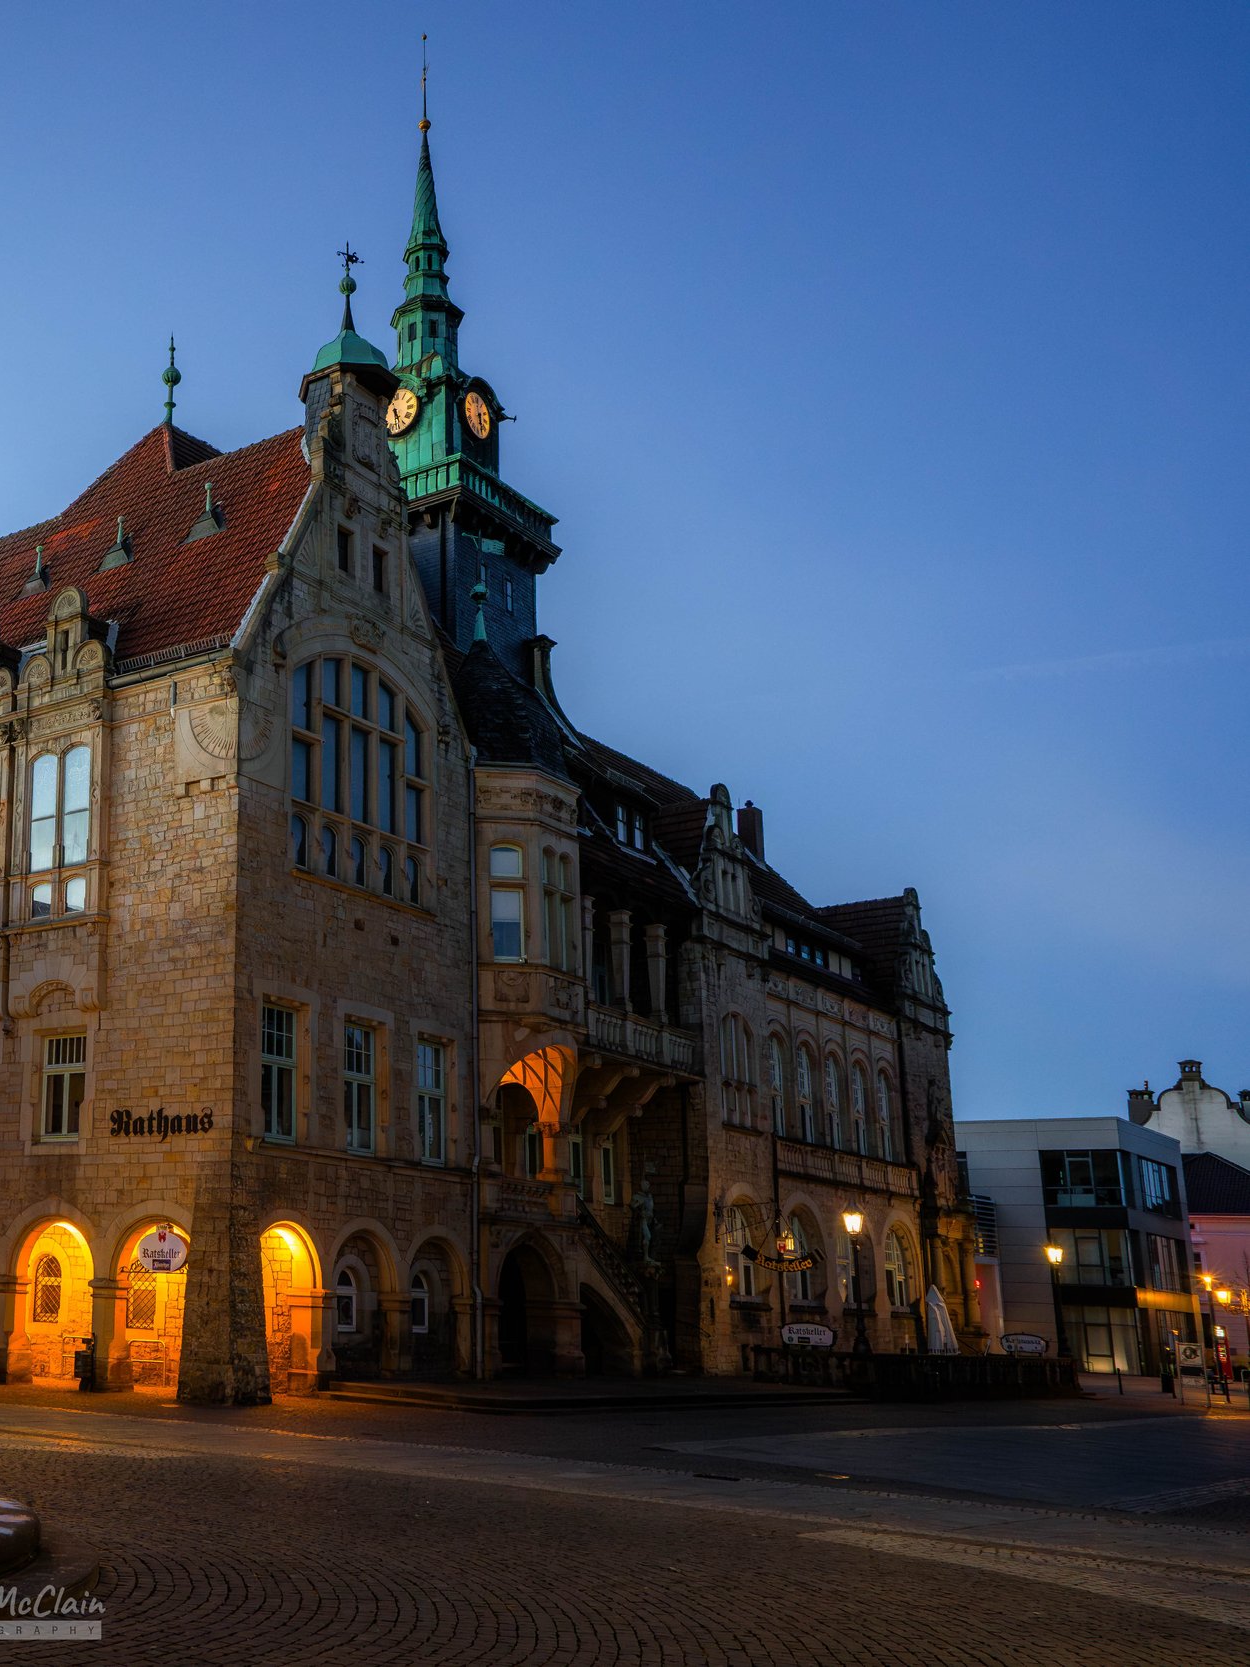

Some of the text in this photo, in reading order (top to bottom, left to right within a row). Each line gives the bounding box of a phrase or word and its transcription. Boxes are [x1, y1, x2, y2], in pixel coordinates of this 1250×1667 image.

[110, 1106, 214, 1143] Rathaus
[142, 1248, 181, 1259] Ratskeller
[755, 1253, 813, 1272] Ratskeller
[788, 1326, 827, 1336] Ratskeller
